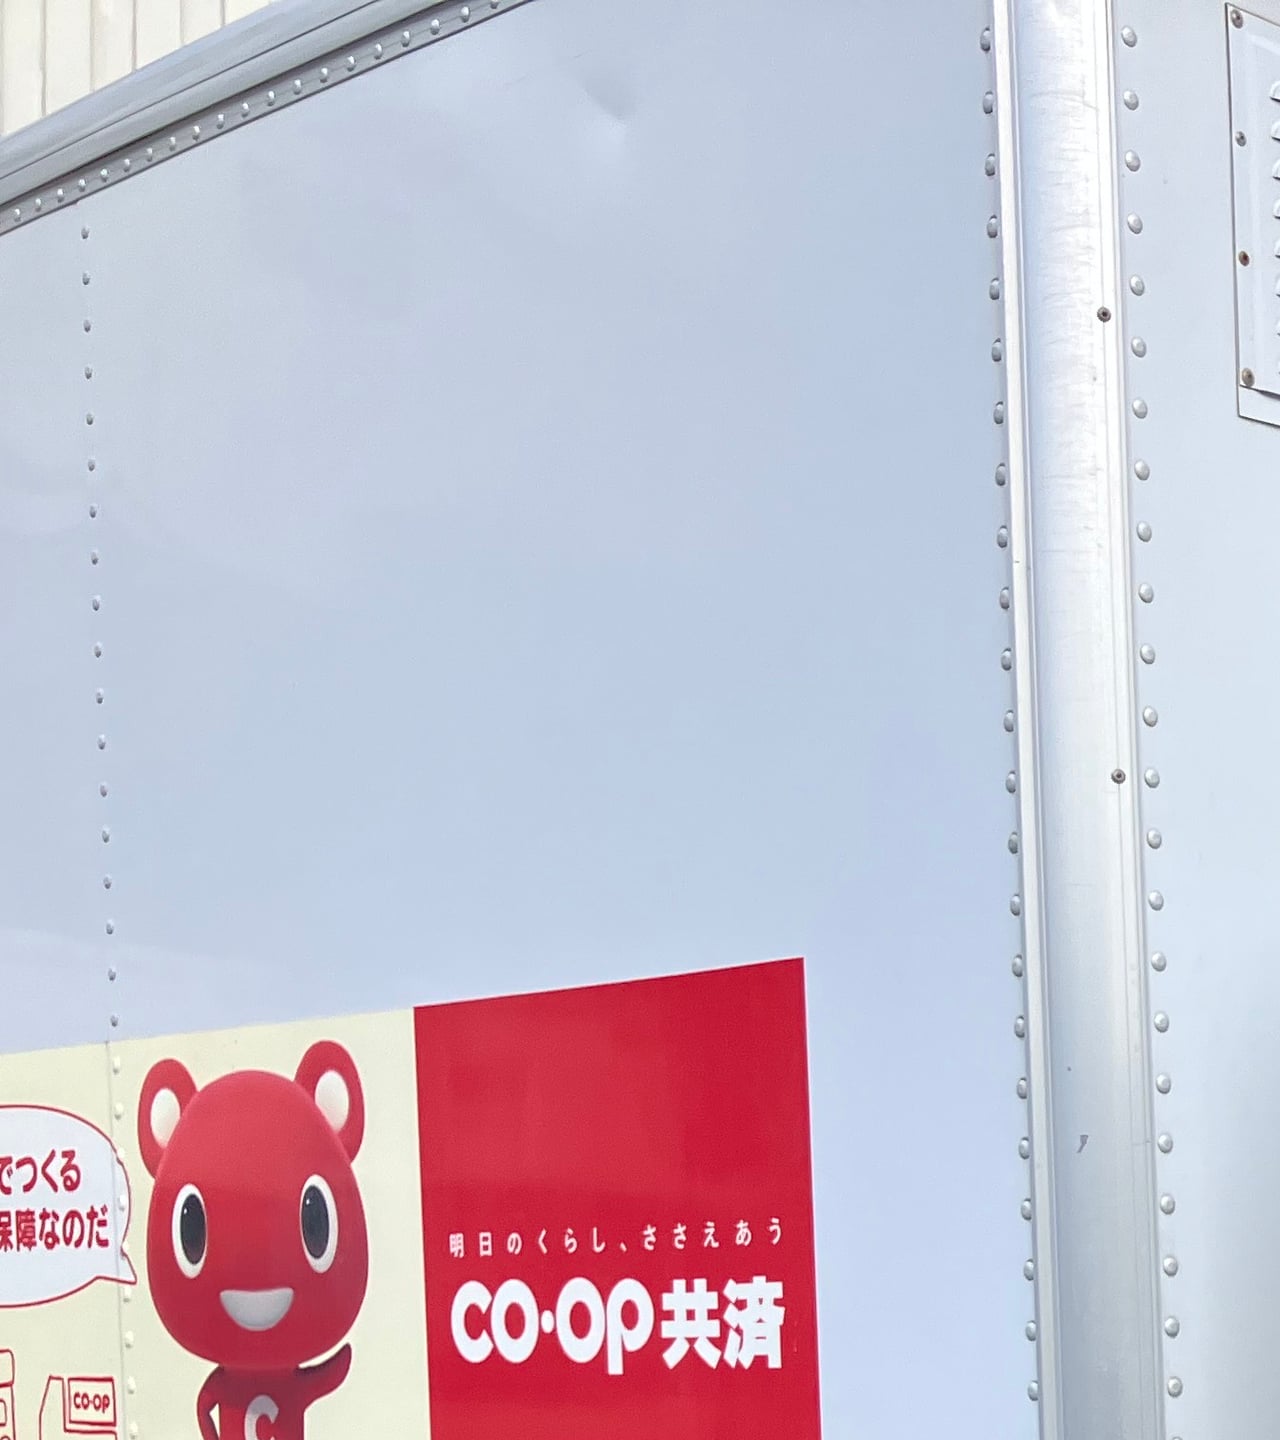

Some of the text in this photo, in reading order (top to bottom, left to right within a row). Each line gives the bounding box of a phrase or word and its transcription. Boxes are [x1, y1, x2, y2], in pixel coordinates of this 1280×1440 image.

[449, 1218, 783, 1258] 明日のくらし、ささえあう
